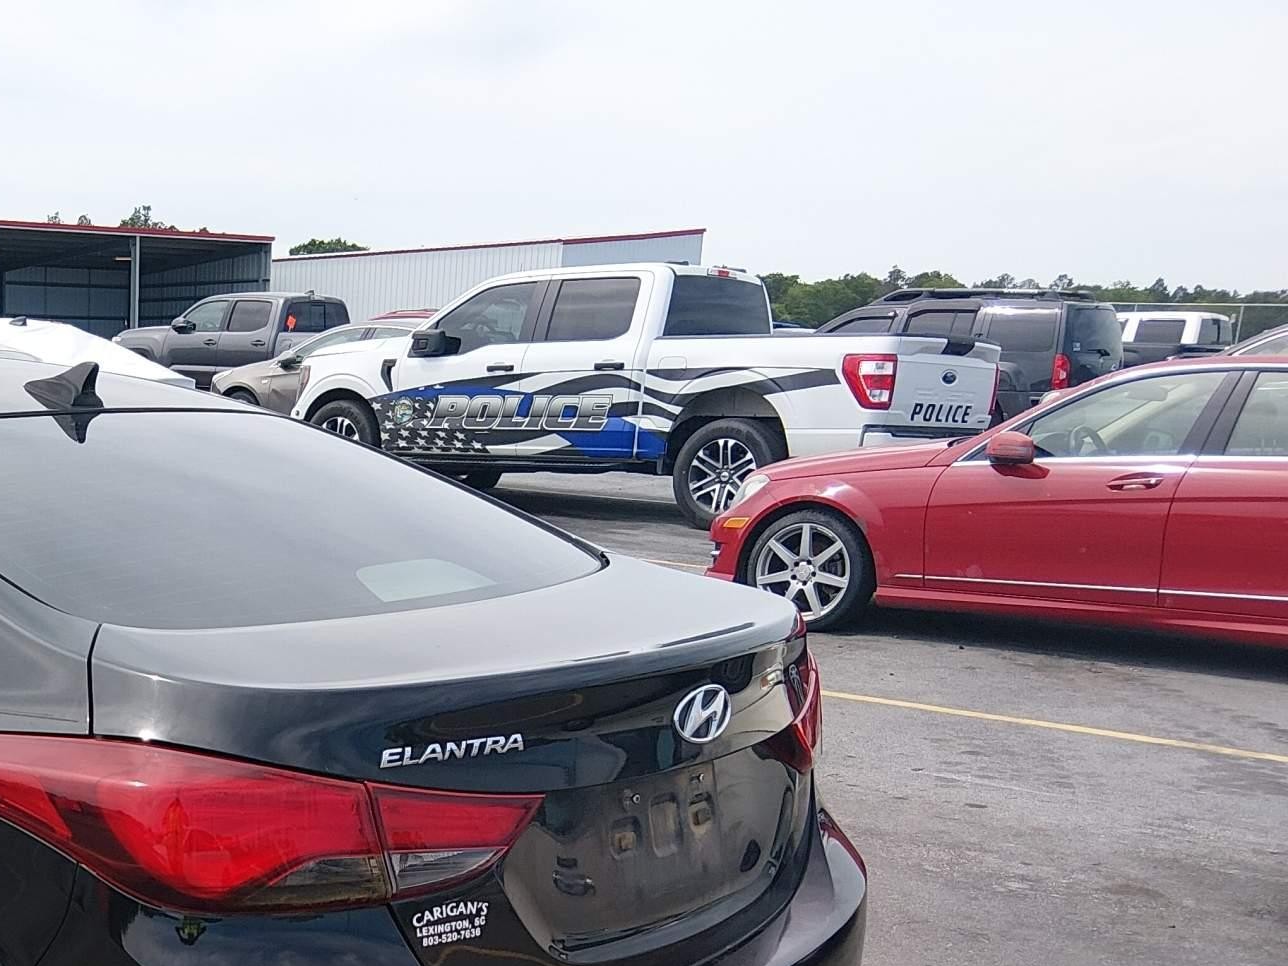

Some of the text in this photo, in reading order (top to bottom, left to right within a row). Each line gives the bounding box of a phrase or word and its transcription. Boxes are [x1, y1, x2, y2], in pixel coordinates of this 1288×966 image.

[425, 394, 613, 431] POLICE
[910, 402, 973, 424] POLICE
[379, 733, 525, 769] ELANTRA
[412, 901, 489, 927] CARIGAN'S
[416, 916, 486, 938] LEXINGTON, SC
